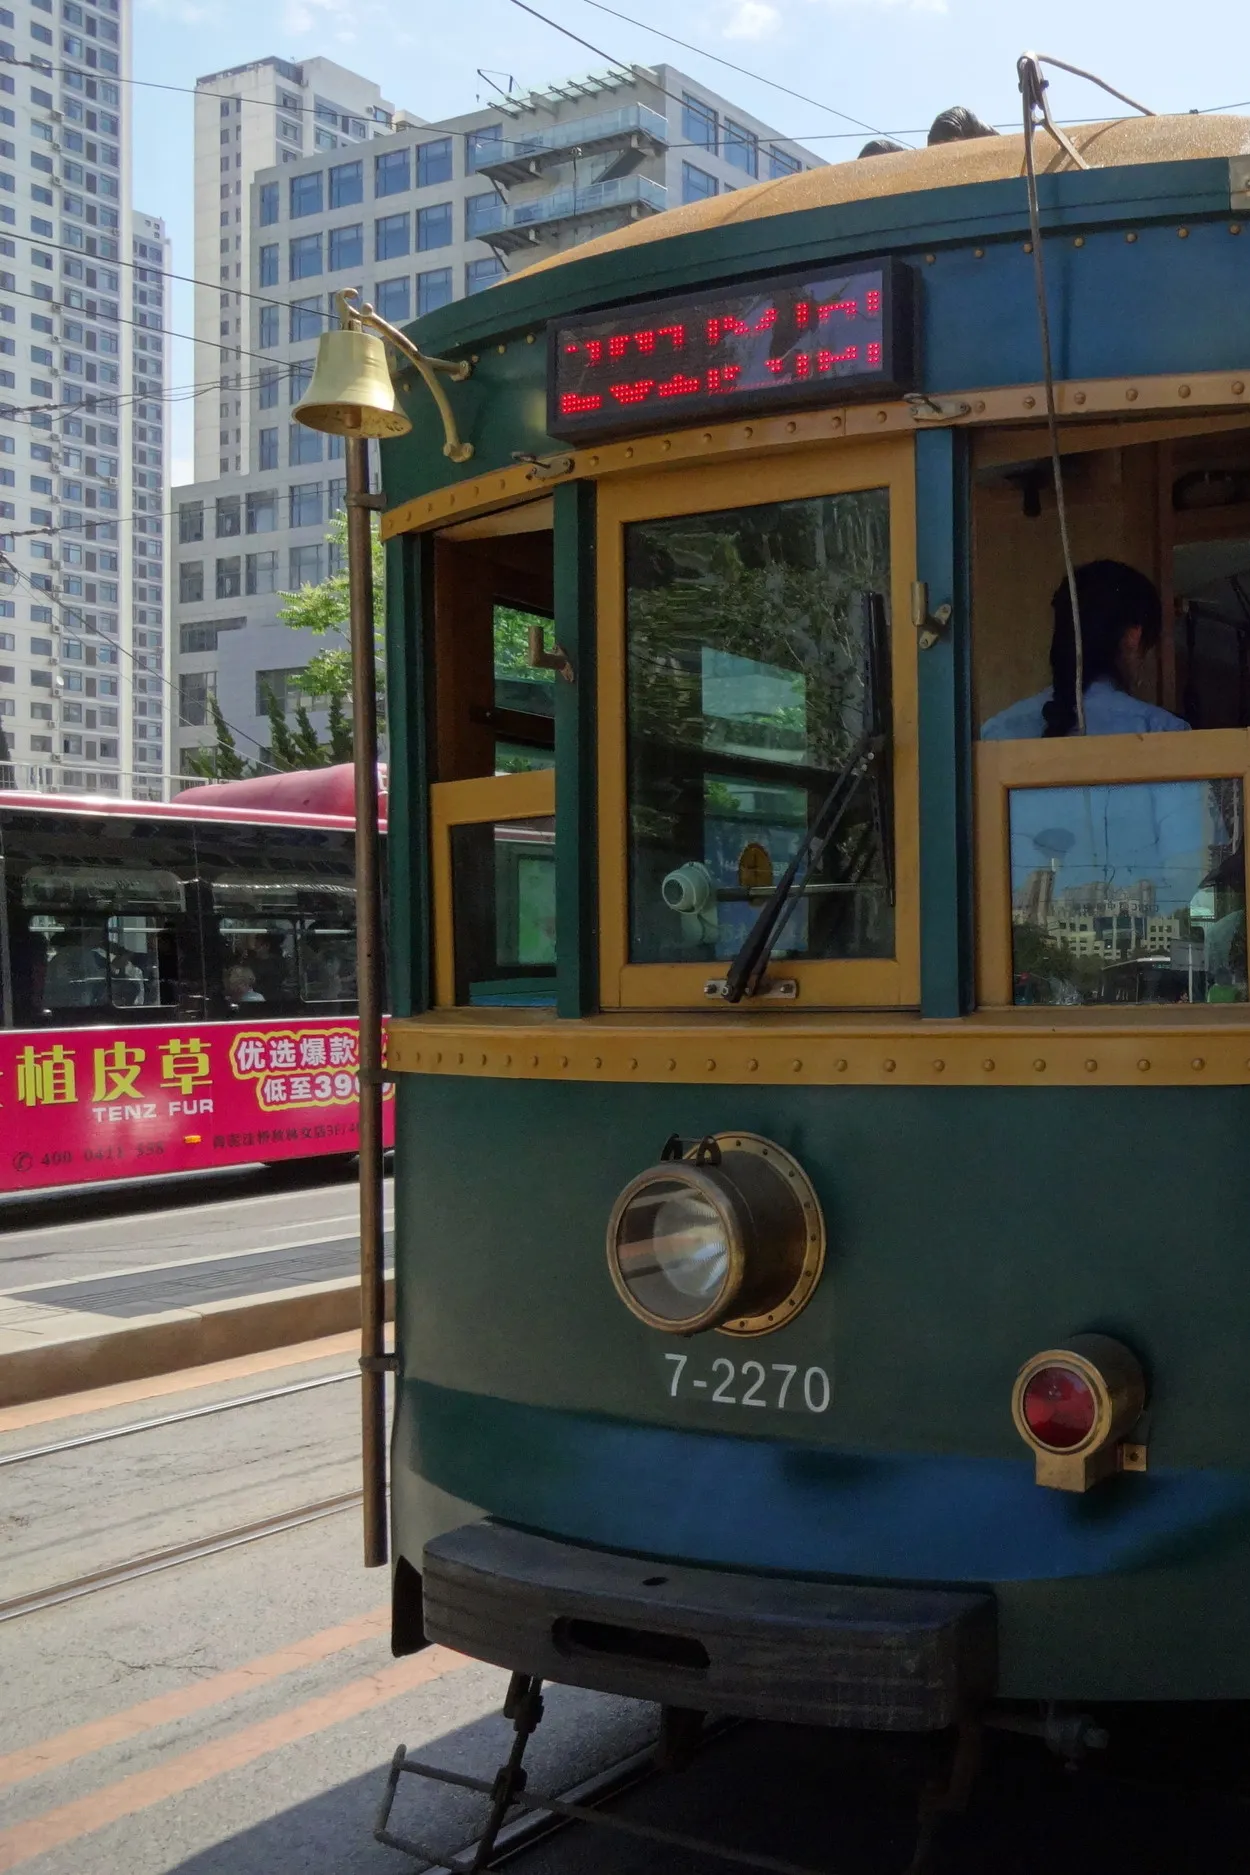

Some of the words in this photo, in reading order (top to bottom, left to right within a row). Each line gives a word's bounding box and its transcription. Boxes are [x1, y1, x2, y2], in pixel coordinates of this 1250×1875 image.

[237, 1035, 357, 1071] 优选爆款
[0, 1038, 213, 1107] 植皮草
[263, 1073, 391, 1103] 低至39
[92, 1103, 157, 1123] TENZ
[168, 1098, 214, 1116] FUR
[664, 1353, 831, 1413] 7-2270
